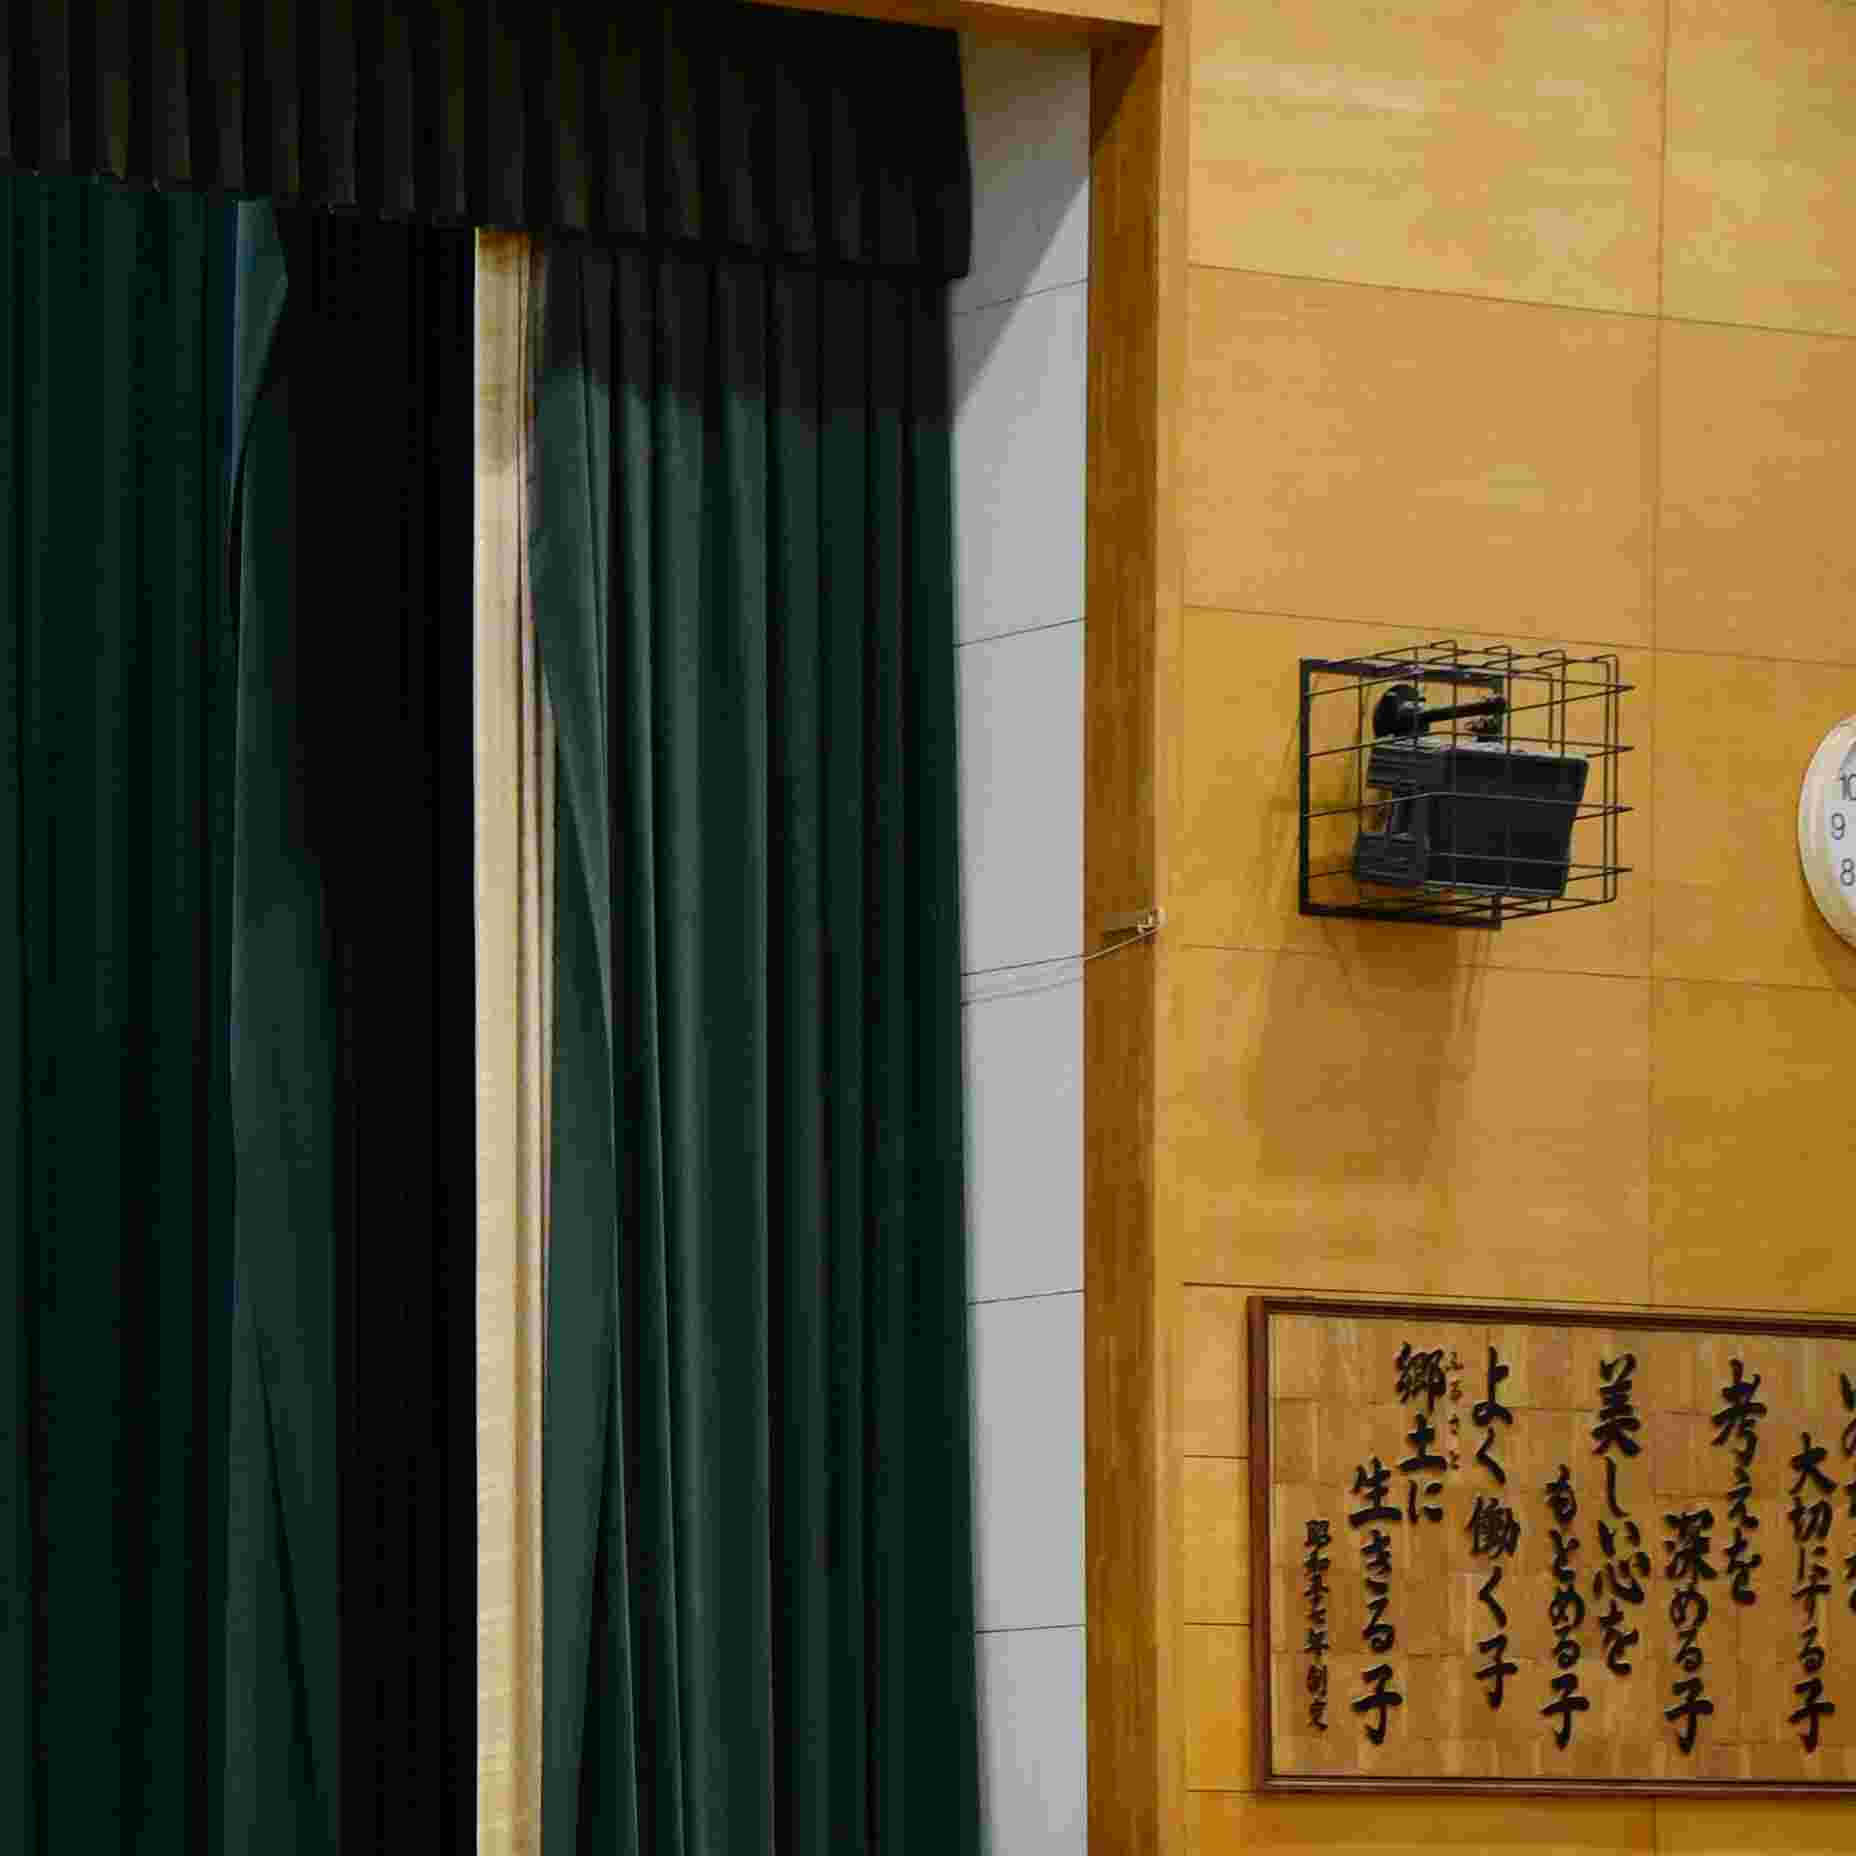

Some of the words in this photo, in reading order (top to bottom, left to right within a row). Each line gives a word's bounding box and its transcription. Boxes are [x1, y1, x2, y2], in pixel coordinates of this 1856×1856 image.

[1831, 812, 1846, 841] 9
[1839, 858, 1855, 888] 8
[1394, 1341, 1450, 1526] 郷土に
[1464, 1345, 1522, 1712] よく働く子
[1591, 1352, 1652, 1677] 美しい心を
[1712, 1358, 1768, 1606] 考えを
[1348, 1455, 1405, 1747] 生きる子
[1540, 1463, 1591, 1751] もとめる子
[1663, 1508, 1718, 1756] 深める子
[1788, 1431, 1838, 1752] 大切にする子
